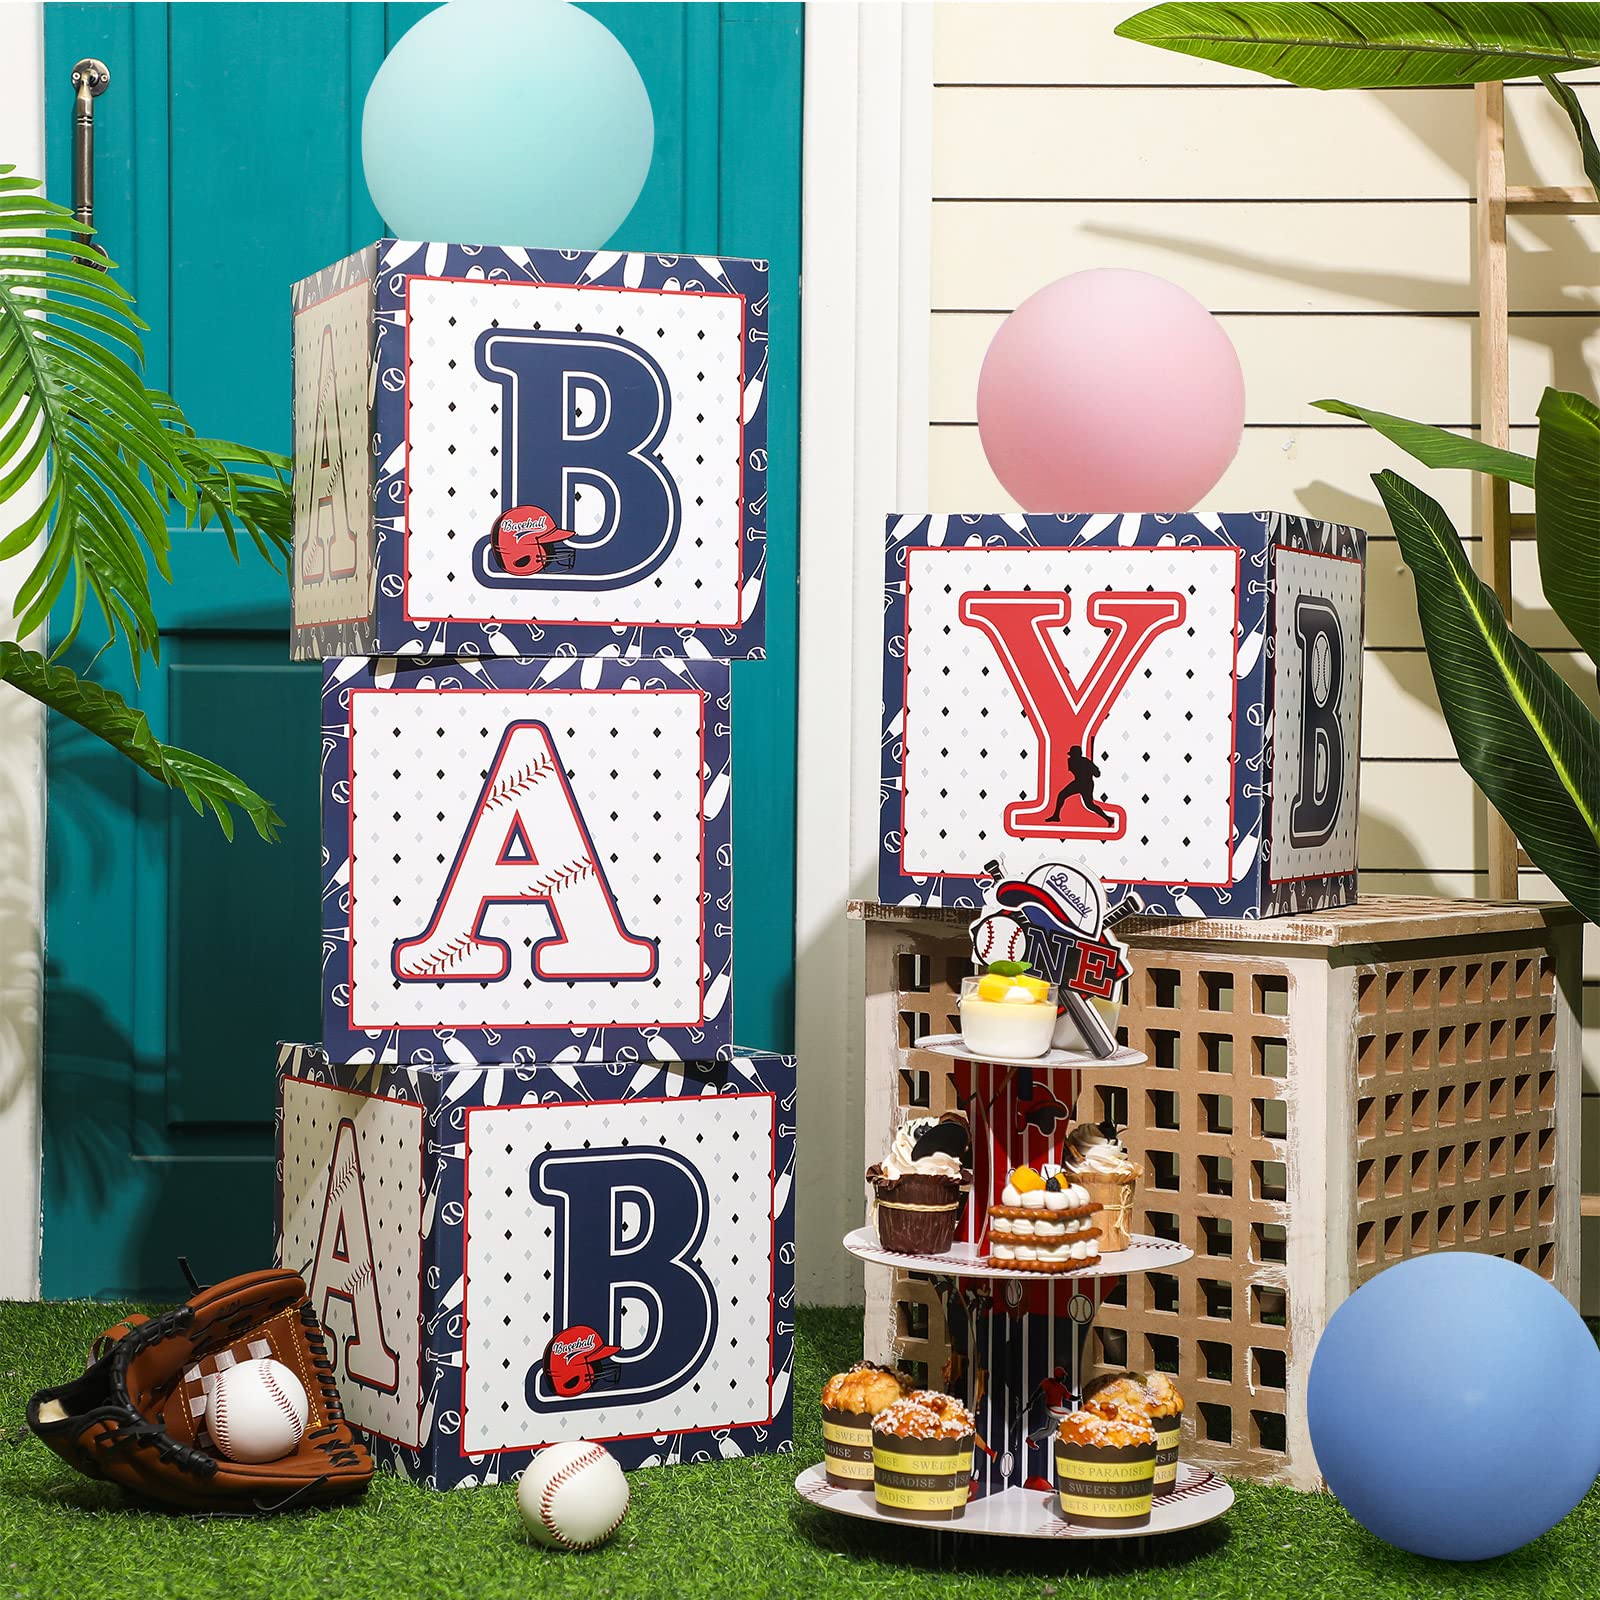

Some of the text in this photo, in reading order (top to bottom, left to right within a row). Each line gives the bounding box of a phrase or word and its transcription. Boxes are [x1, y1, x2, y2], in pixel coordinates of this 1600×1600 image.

[301, 324, 357, 585] A
[472, 328, 682, 591] B
[501, 516, 547, 532] Baseball
[959, 591, 1186, 840] Y
[1289, 594, 1344, 848] B
[391, 719, 659, 982] A
[1050, 872, 1093, 918] Baseball
[309, 1118, 399, 1395] A
[524, 1145, 719, 1414] B
[552, 1334, 595, 1355] Baseball
[912, 1460, 957, 1471] SWEETS
[1069, 1482, 1117, 1496] SWEETS
[1089, 1465, 1144, 1478] PARADISE
[1093, 1501, 1146, 1513] PARADISE
